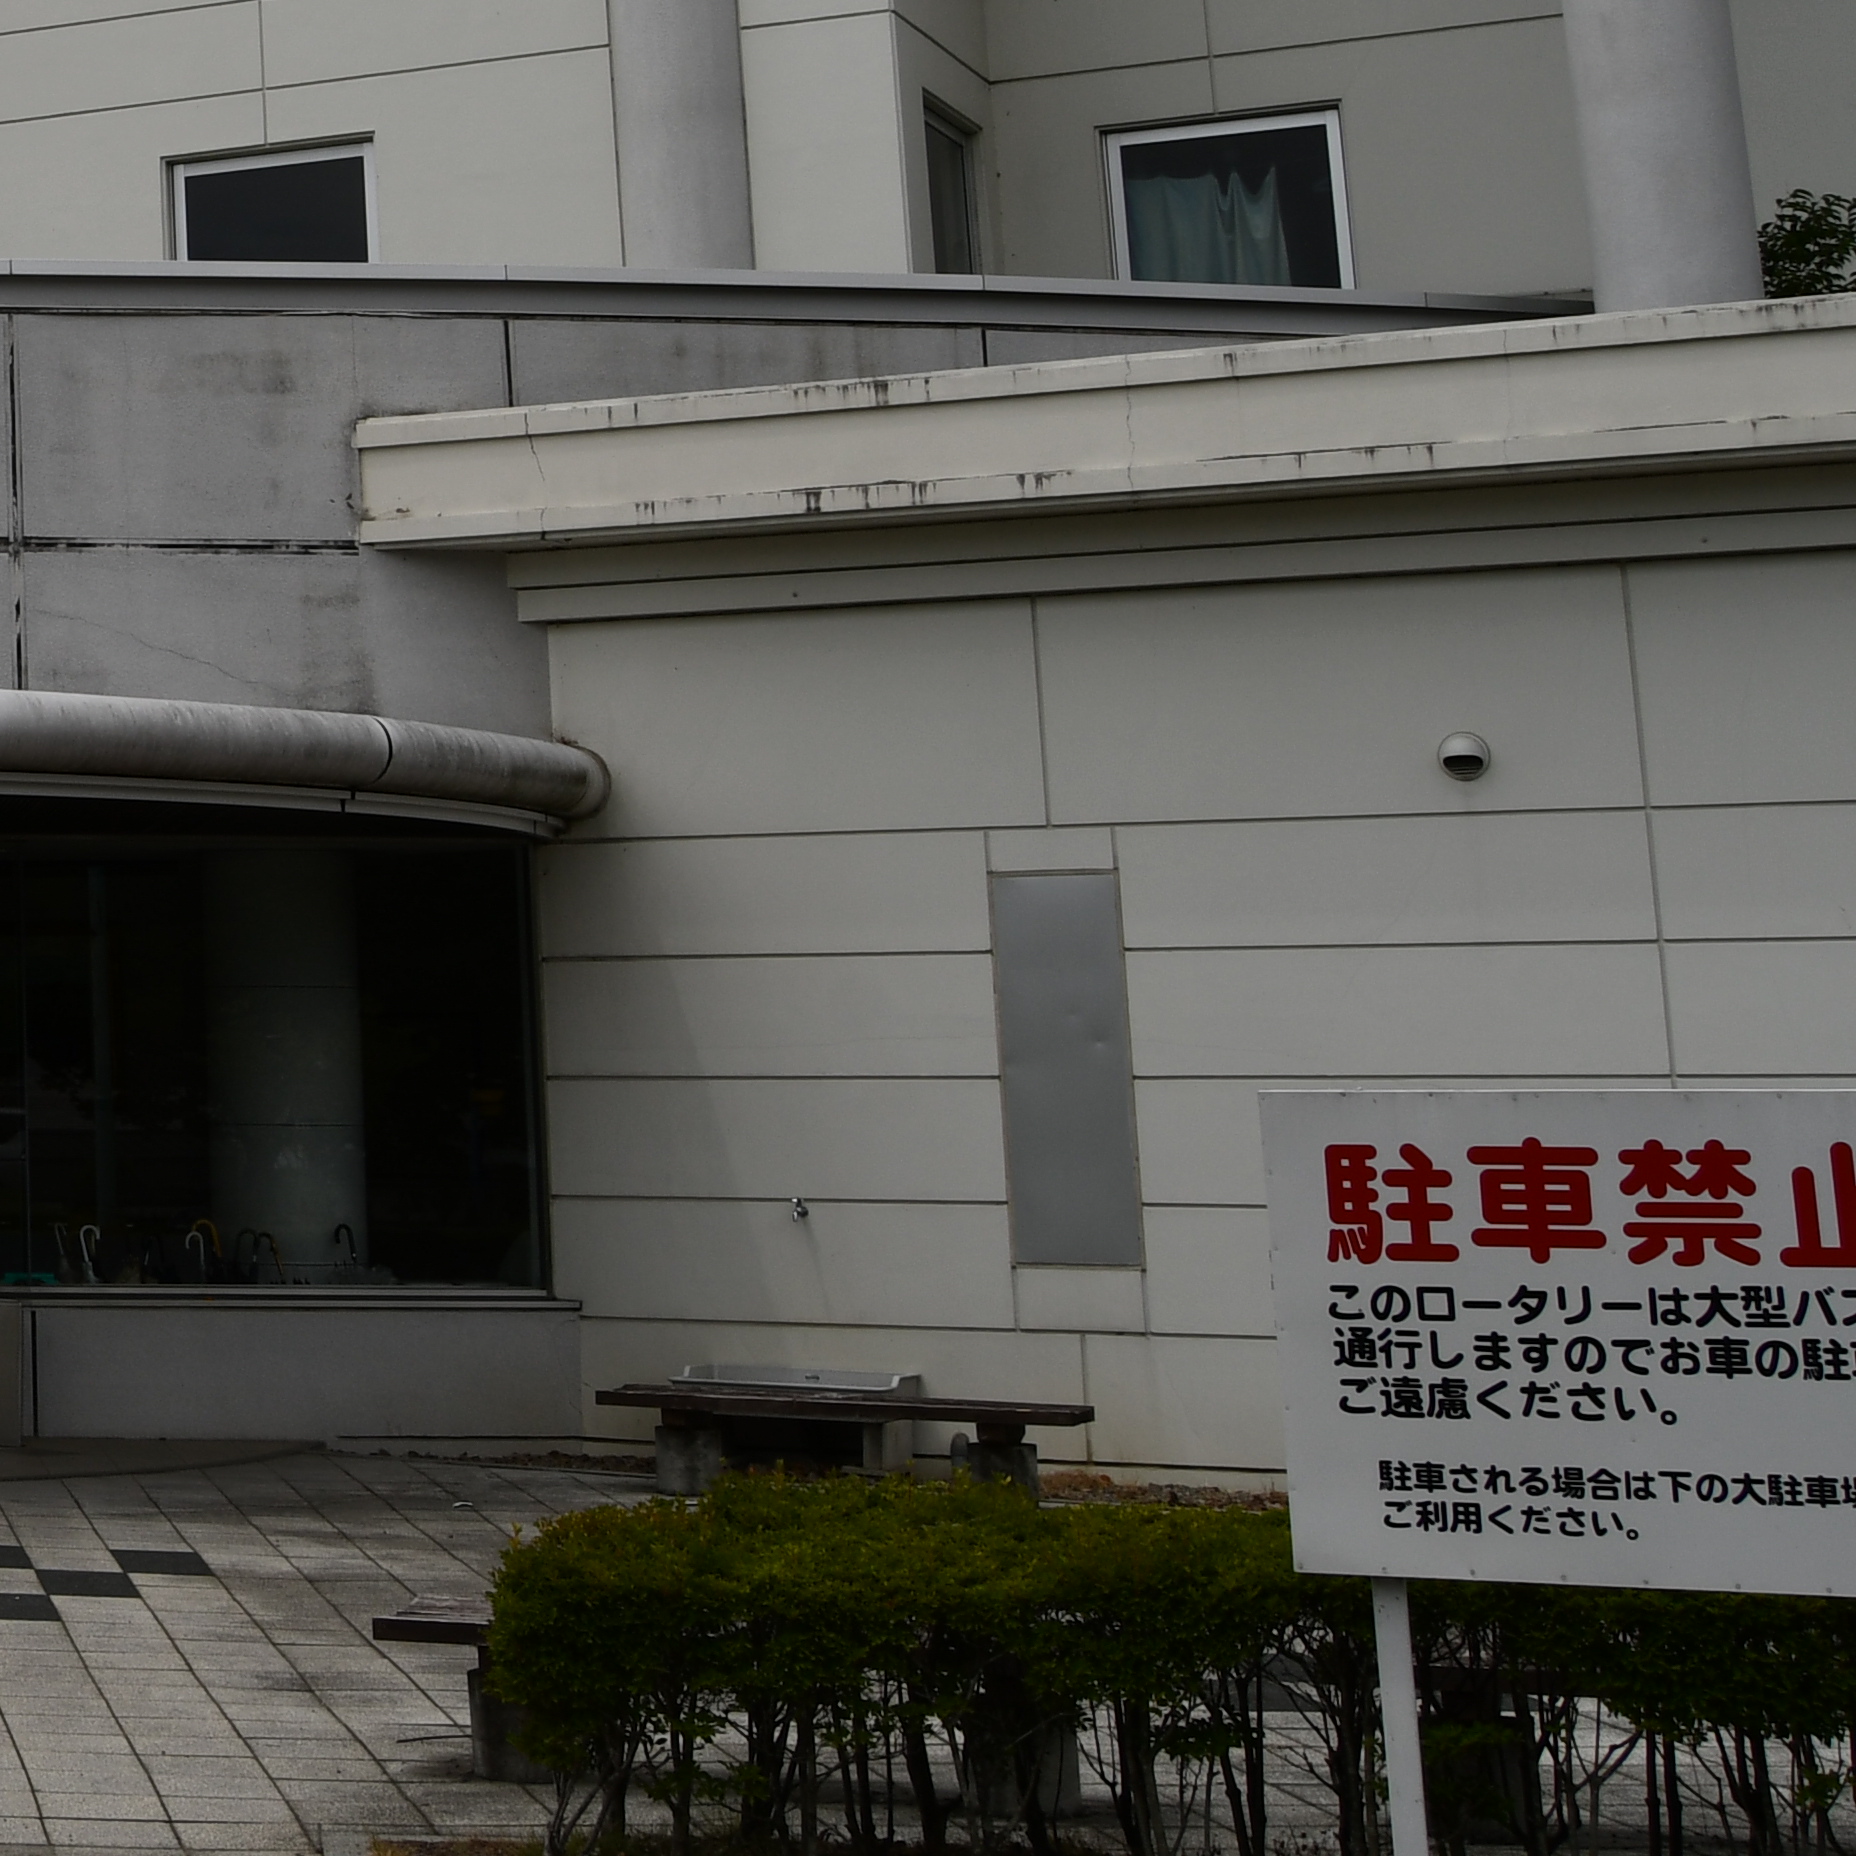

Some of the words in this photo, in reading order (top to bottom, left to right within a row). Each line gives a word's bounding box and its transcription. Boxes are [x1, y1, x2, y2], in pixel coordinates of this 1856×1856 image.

[1333, 1327, 1856, 1381] 通行しますのでお車の駐
[1339, 1377, 1678, 1426] ご遠慮ください。
[1383, 1499, 1640, 1541] ご利用ください。
